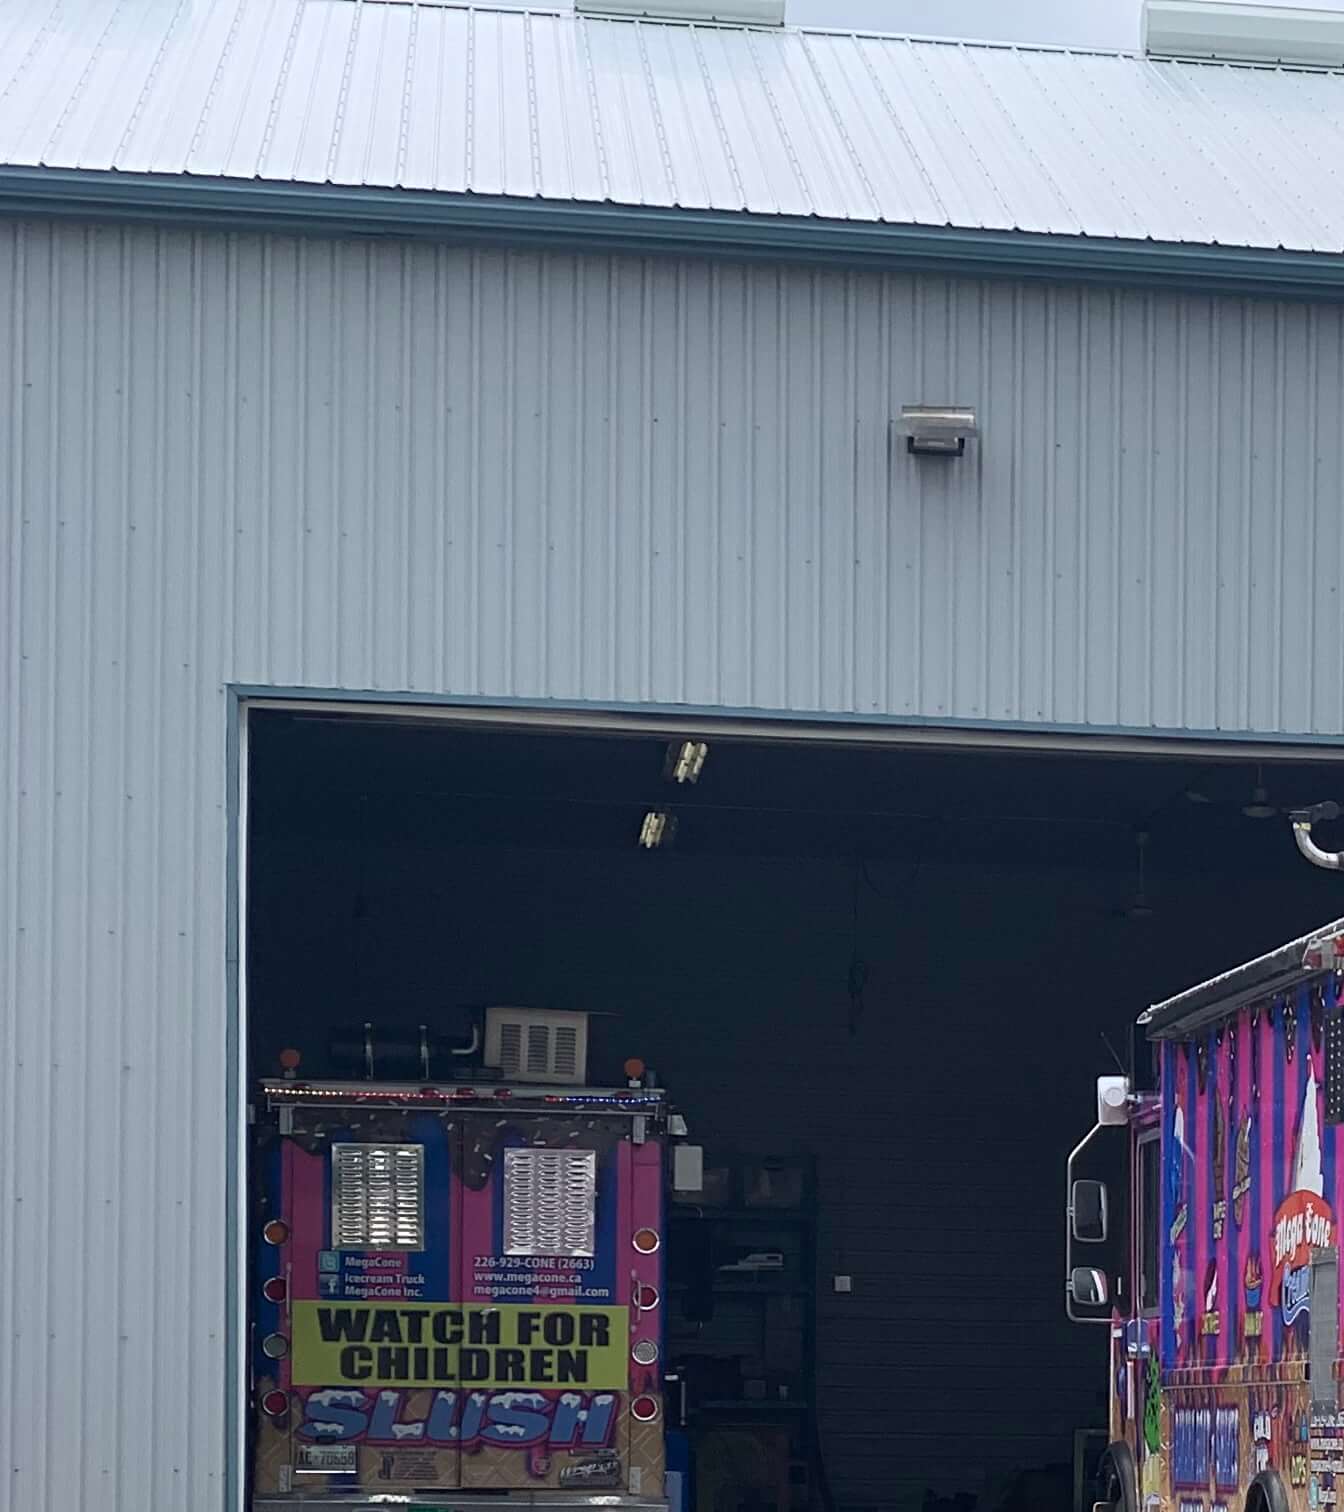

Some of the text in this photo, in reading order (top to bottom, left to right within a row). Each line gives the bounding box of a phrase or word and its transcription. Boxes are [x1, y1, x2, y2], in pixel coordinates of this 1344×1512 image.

[473, 1256, 595, 1271] 226-929-CONE (2663)
[345, 1273, 425, 1285] Icecream Truck
[473, 1271, 582, 1285] www.megacone.ca
[317, 1307, 611, 1347] WATCH FOR
[339, 1345, 589, 1383] CHILDREN
[302, 1389, 615, 1443] SLUSH
